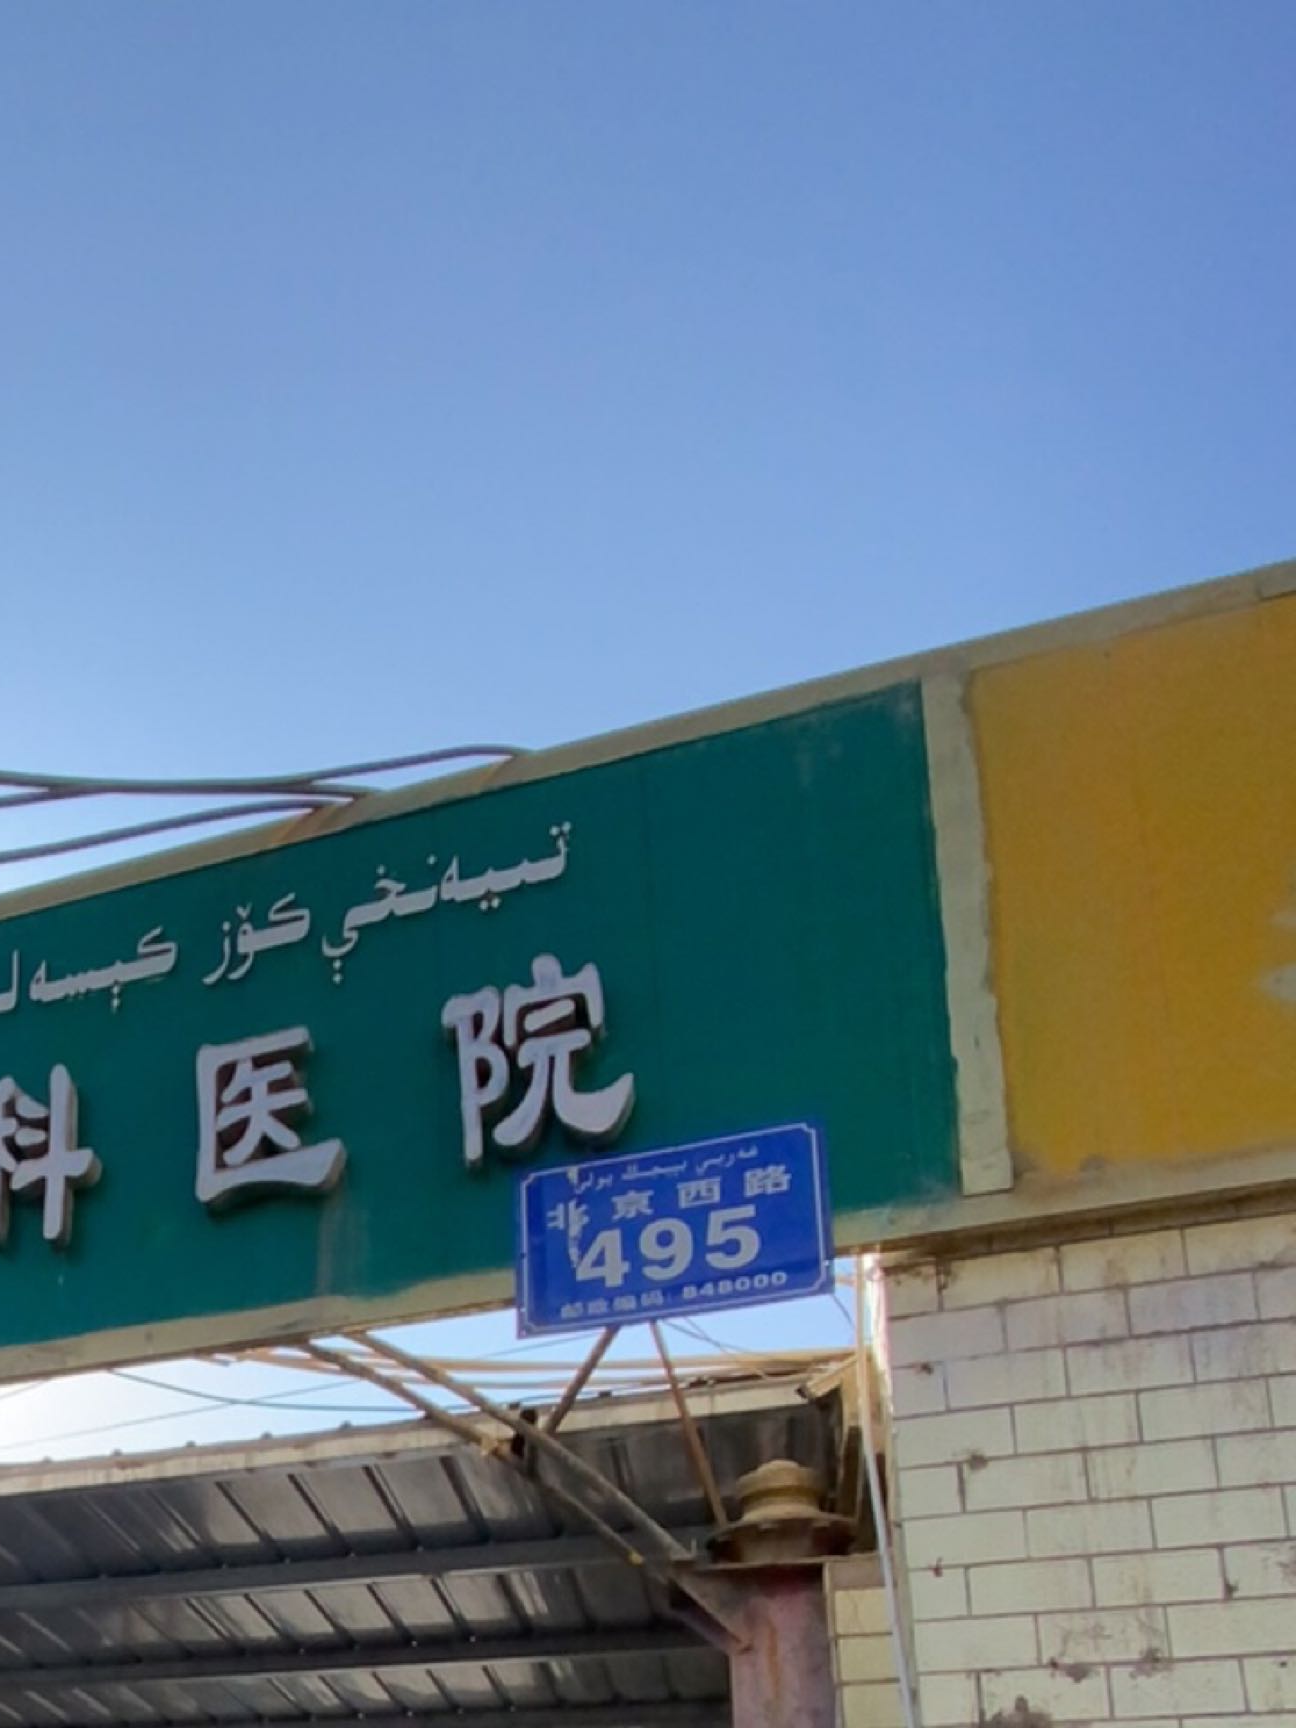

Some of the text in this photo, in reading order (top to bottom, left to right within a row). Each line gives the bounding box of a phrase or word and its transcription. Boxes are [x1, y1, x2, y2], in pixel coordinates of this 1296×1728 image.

[546, 1164, 791, 1230] 北京西路
[575, 1204, 762, 1288] 495
